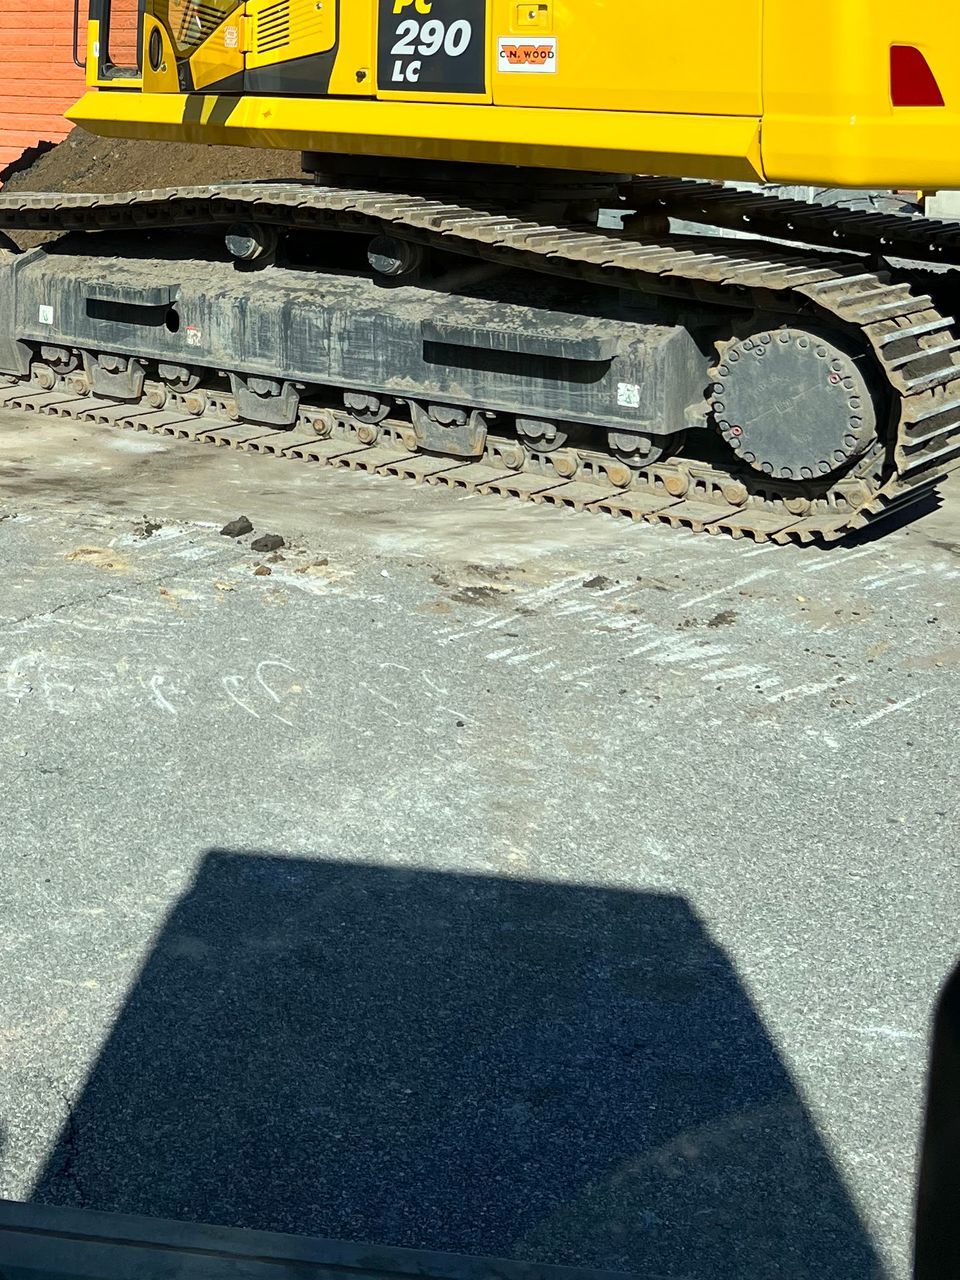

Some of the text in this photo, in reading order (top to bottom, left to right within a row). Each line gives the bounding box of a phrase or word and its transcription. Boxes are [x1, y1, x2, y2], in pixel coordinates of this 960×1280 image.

[390, 19, 472, 57] 290
[499, 50, 554, 59] C.N. WOOD
[391, 60, 422, 83] LC
